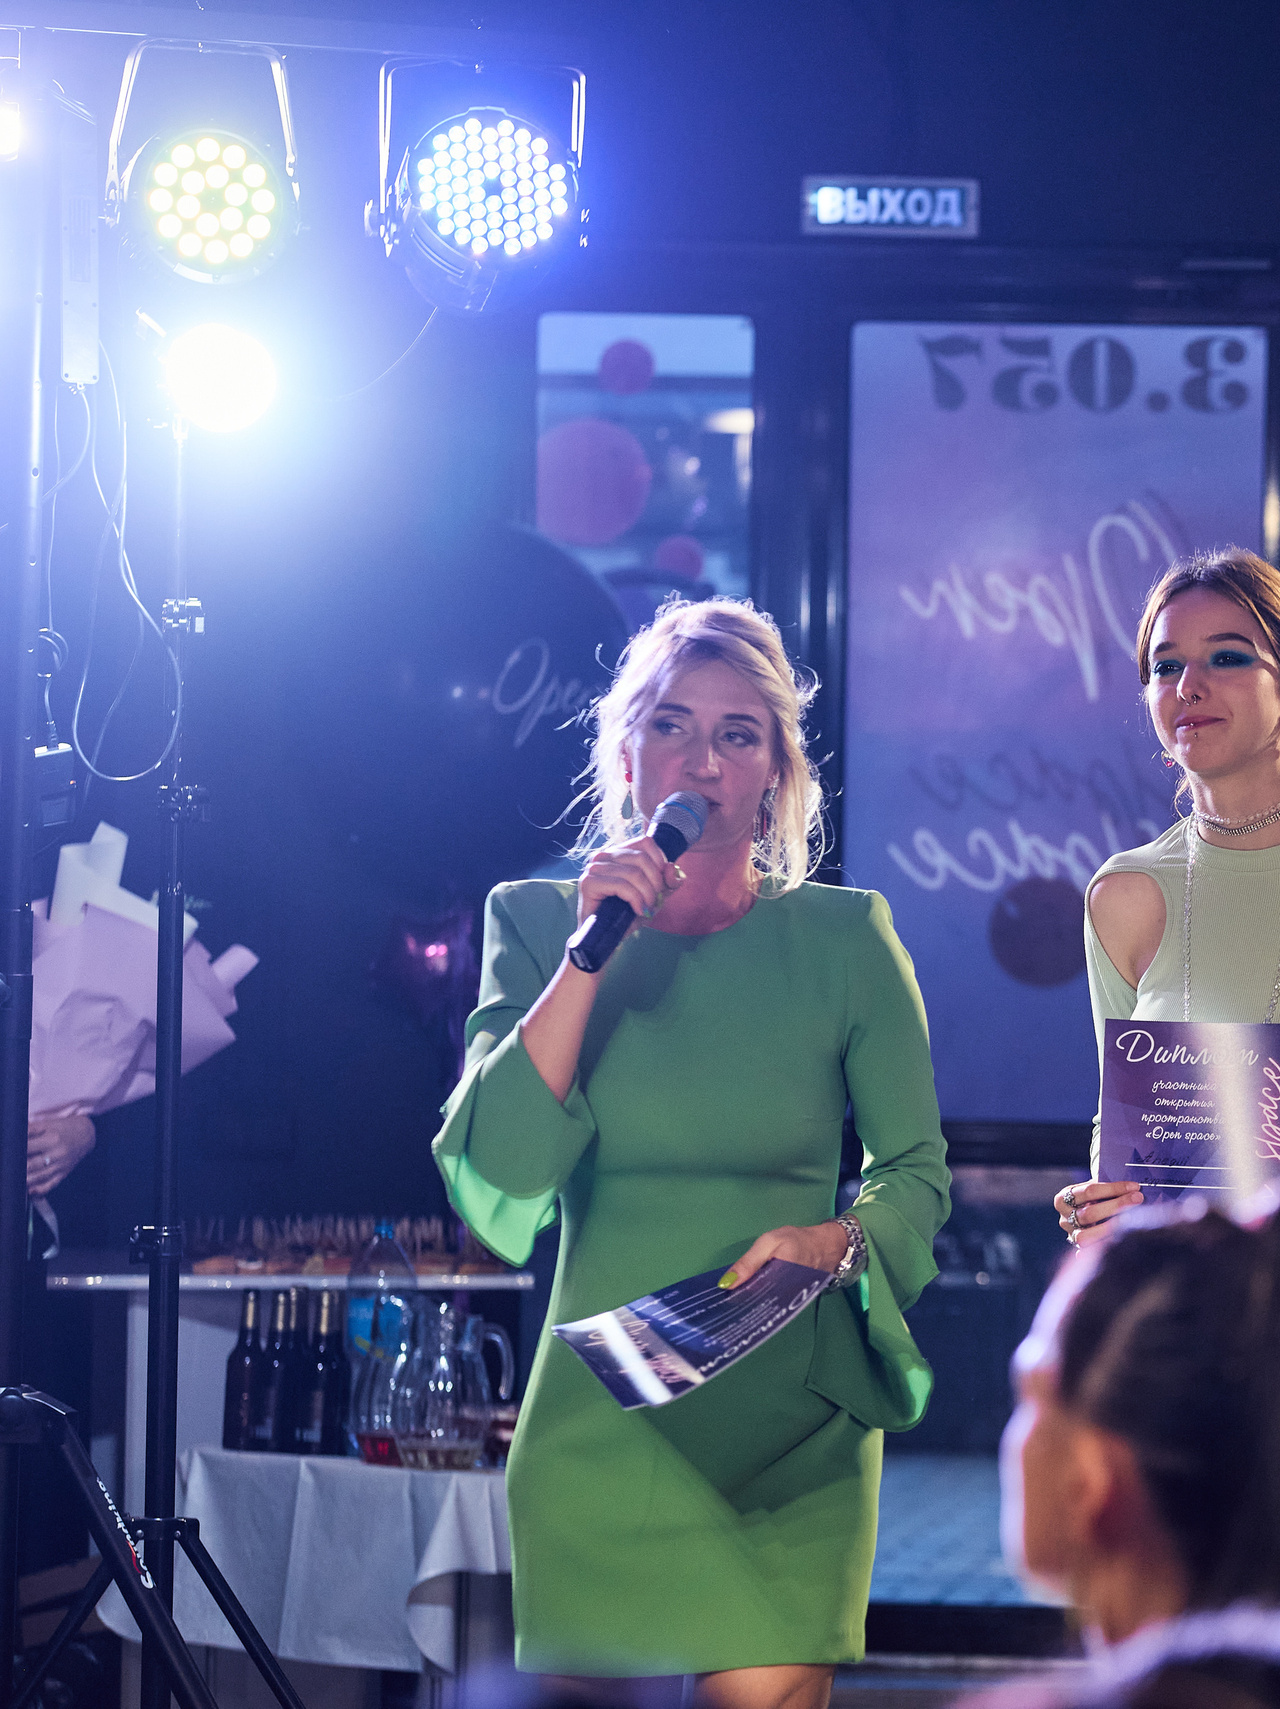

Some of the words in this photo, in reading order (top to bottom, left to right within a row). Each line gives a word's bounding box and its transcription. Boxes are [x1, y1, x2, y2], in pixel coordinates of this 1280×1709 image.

[814, 186, 963, 226] ВЫХОД
[492, 636, 604, 749] Ope
[1154, 1097, 1216, 1110] открытия
